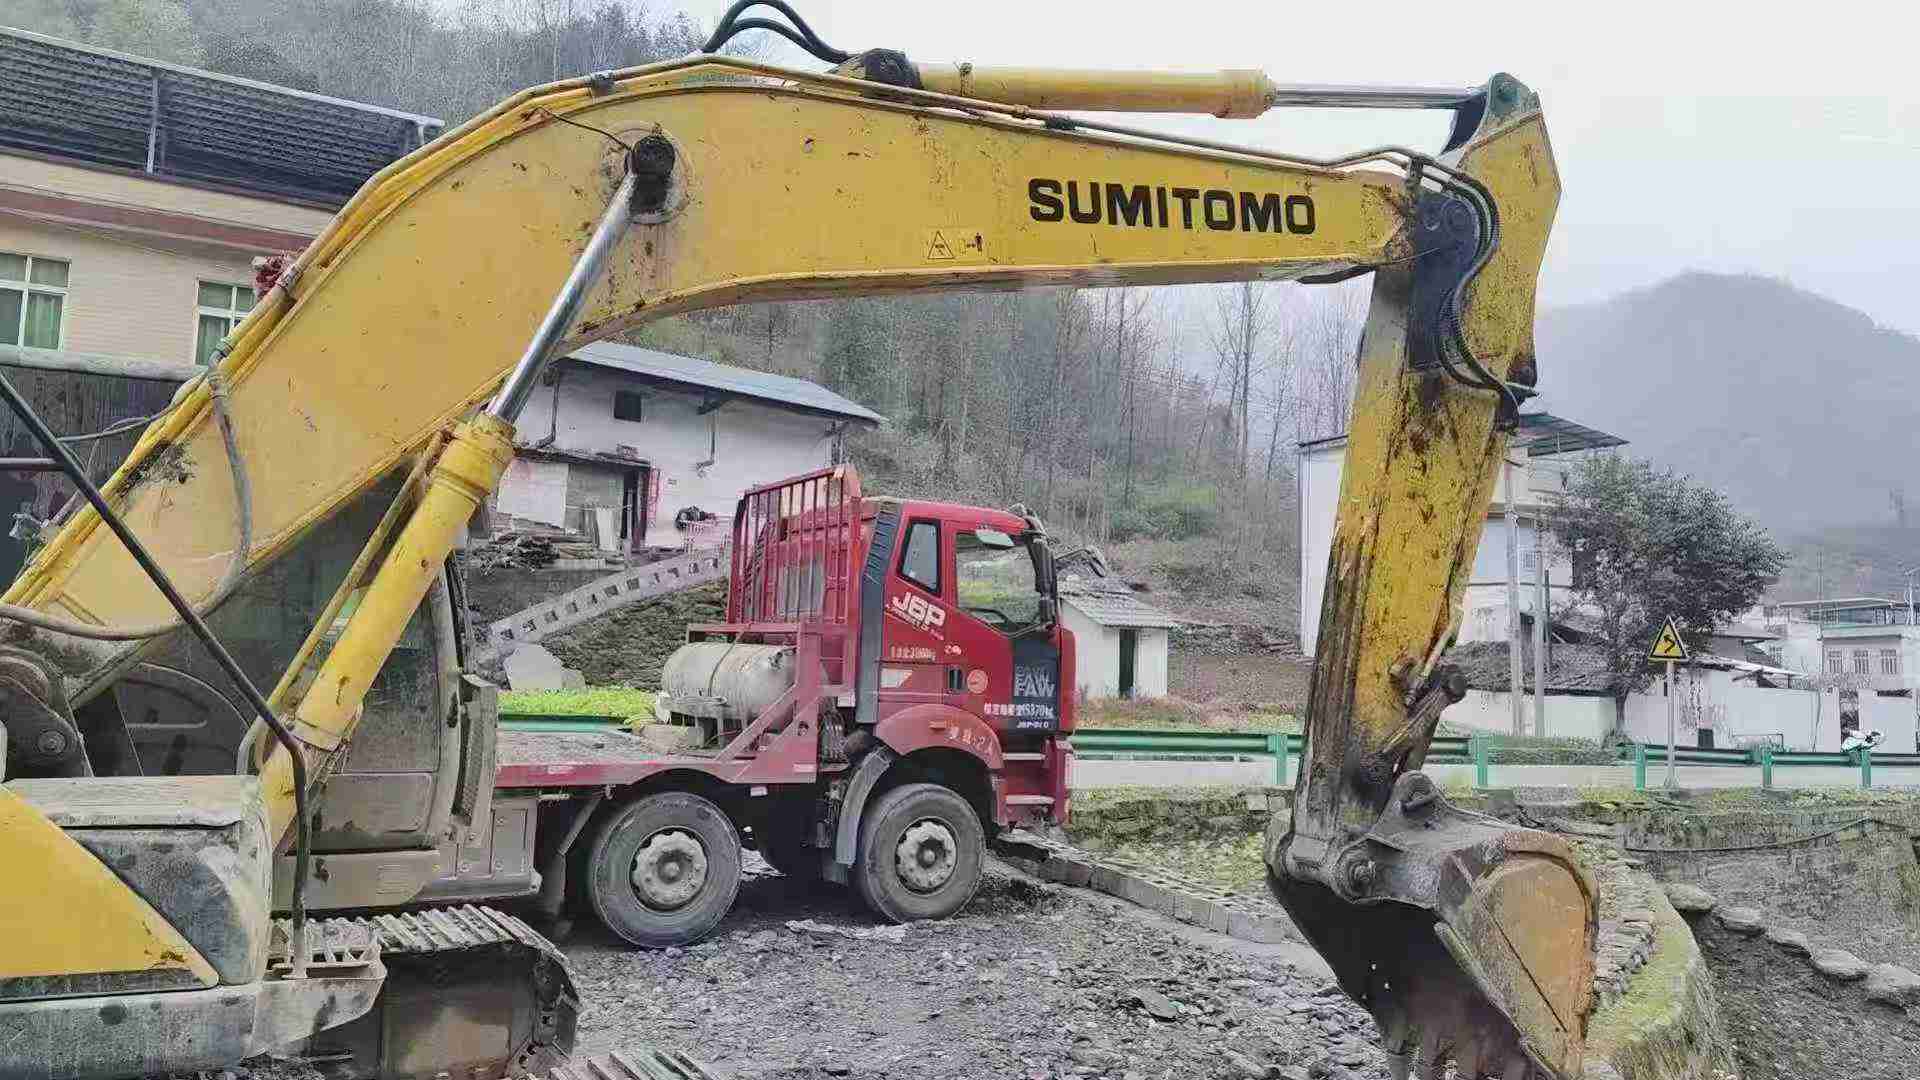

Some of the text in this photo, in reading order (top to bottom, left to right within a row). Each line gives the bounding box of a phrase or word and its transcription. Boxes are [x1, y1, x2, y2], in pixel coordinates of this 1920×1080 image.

[1028, 178, 1316, 235] SUMITOMO
[892, 592, 946, 626] J6P
[1014, 682, 1055, 697] FAW
